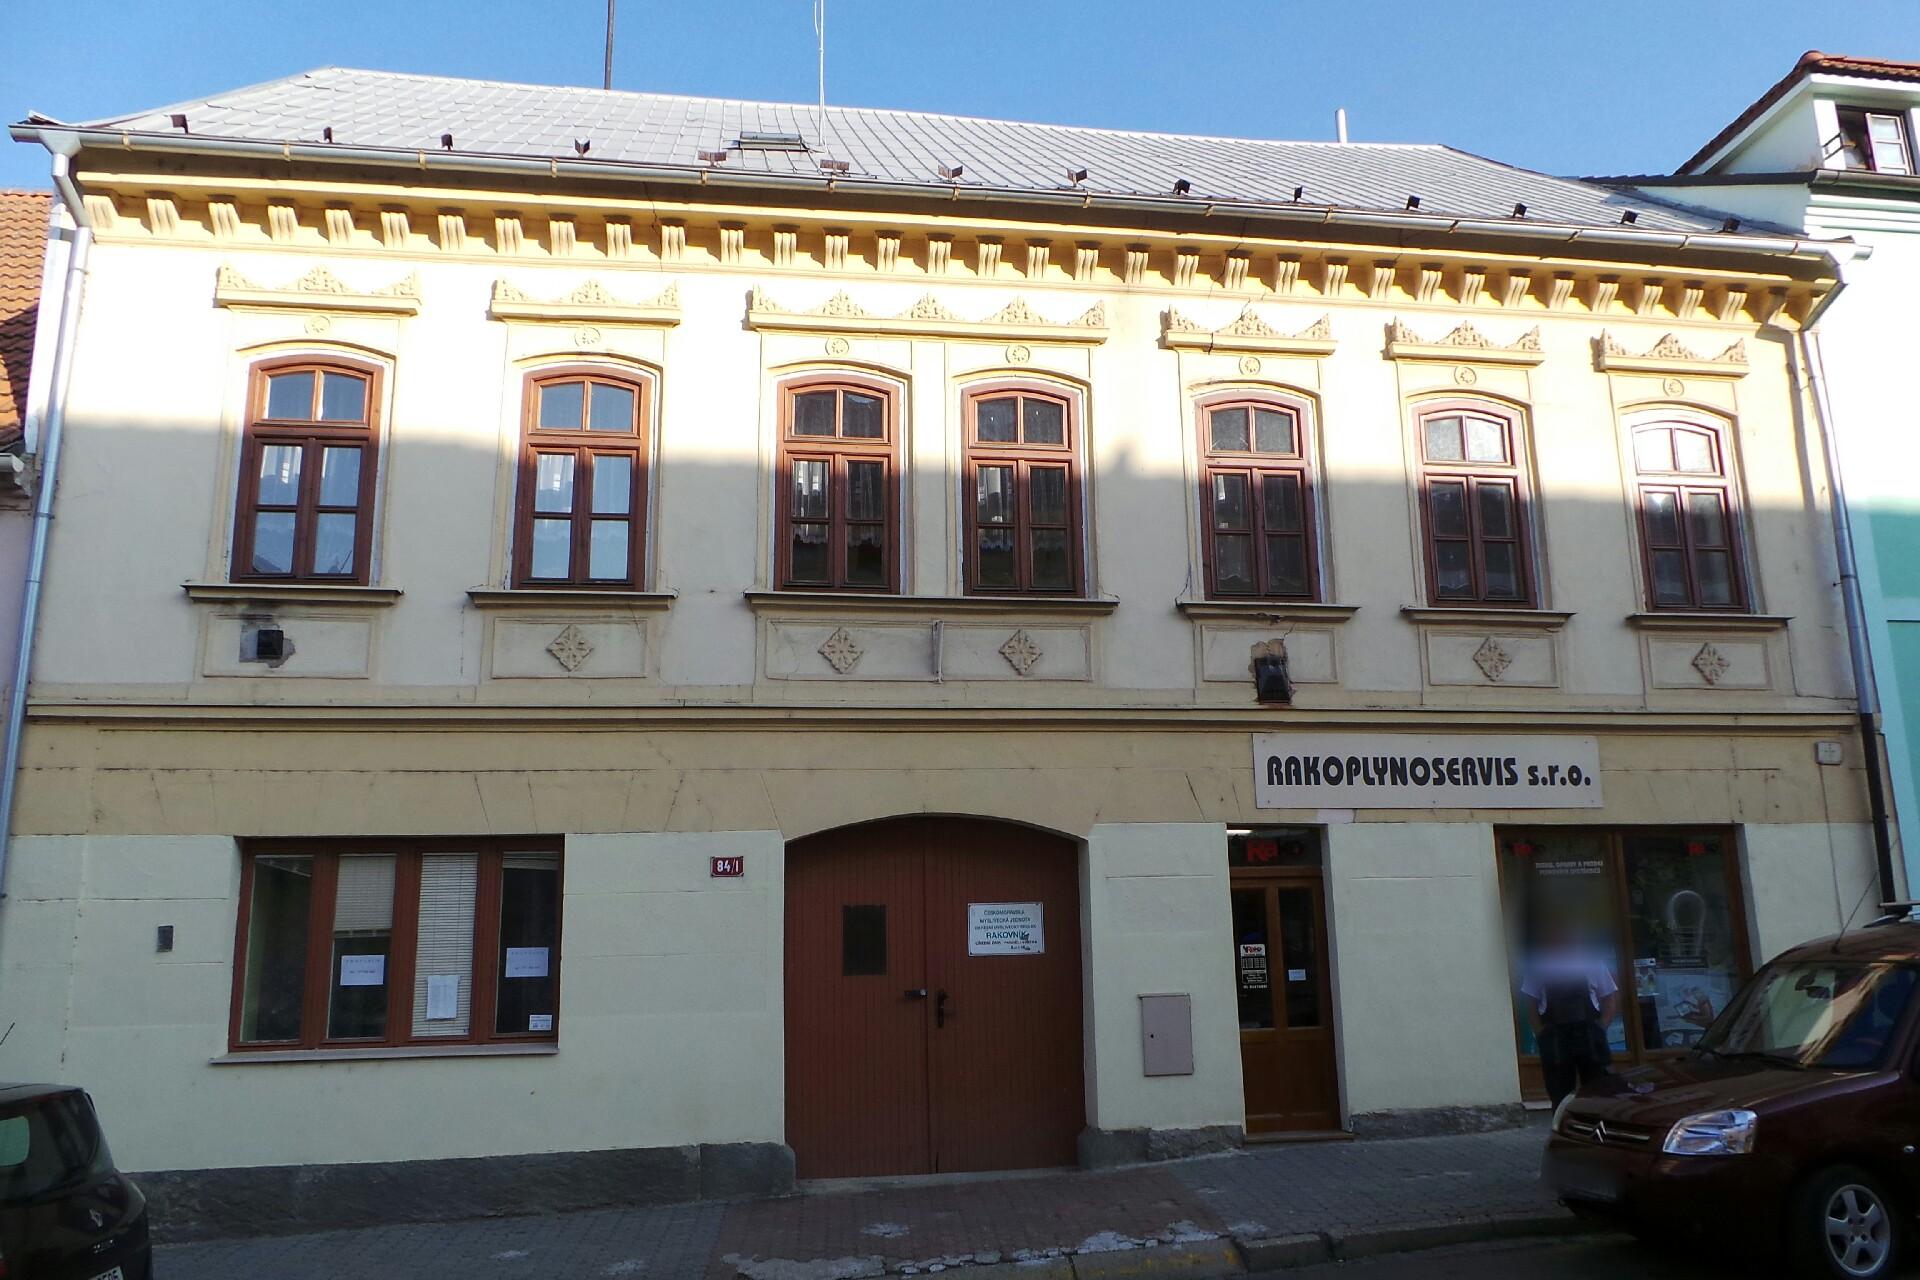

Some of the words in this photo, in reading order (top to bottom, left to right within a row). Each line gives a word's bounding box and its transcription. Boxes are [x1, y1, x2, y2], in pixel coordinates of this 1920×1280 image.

[1266, 755, 1518, 787] RAKOPLYNOSERVIS
[1527, 763, 1592, 786] s.r.o.
[716, 858, 739, 874] 84/1
